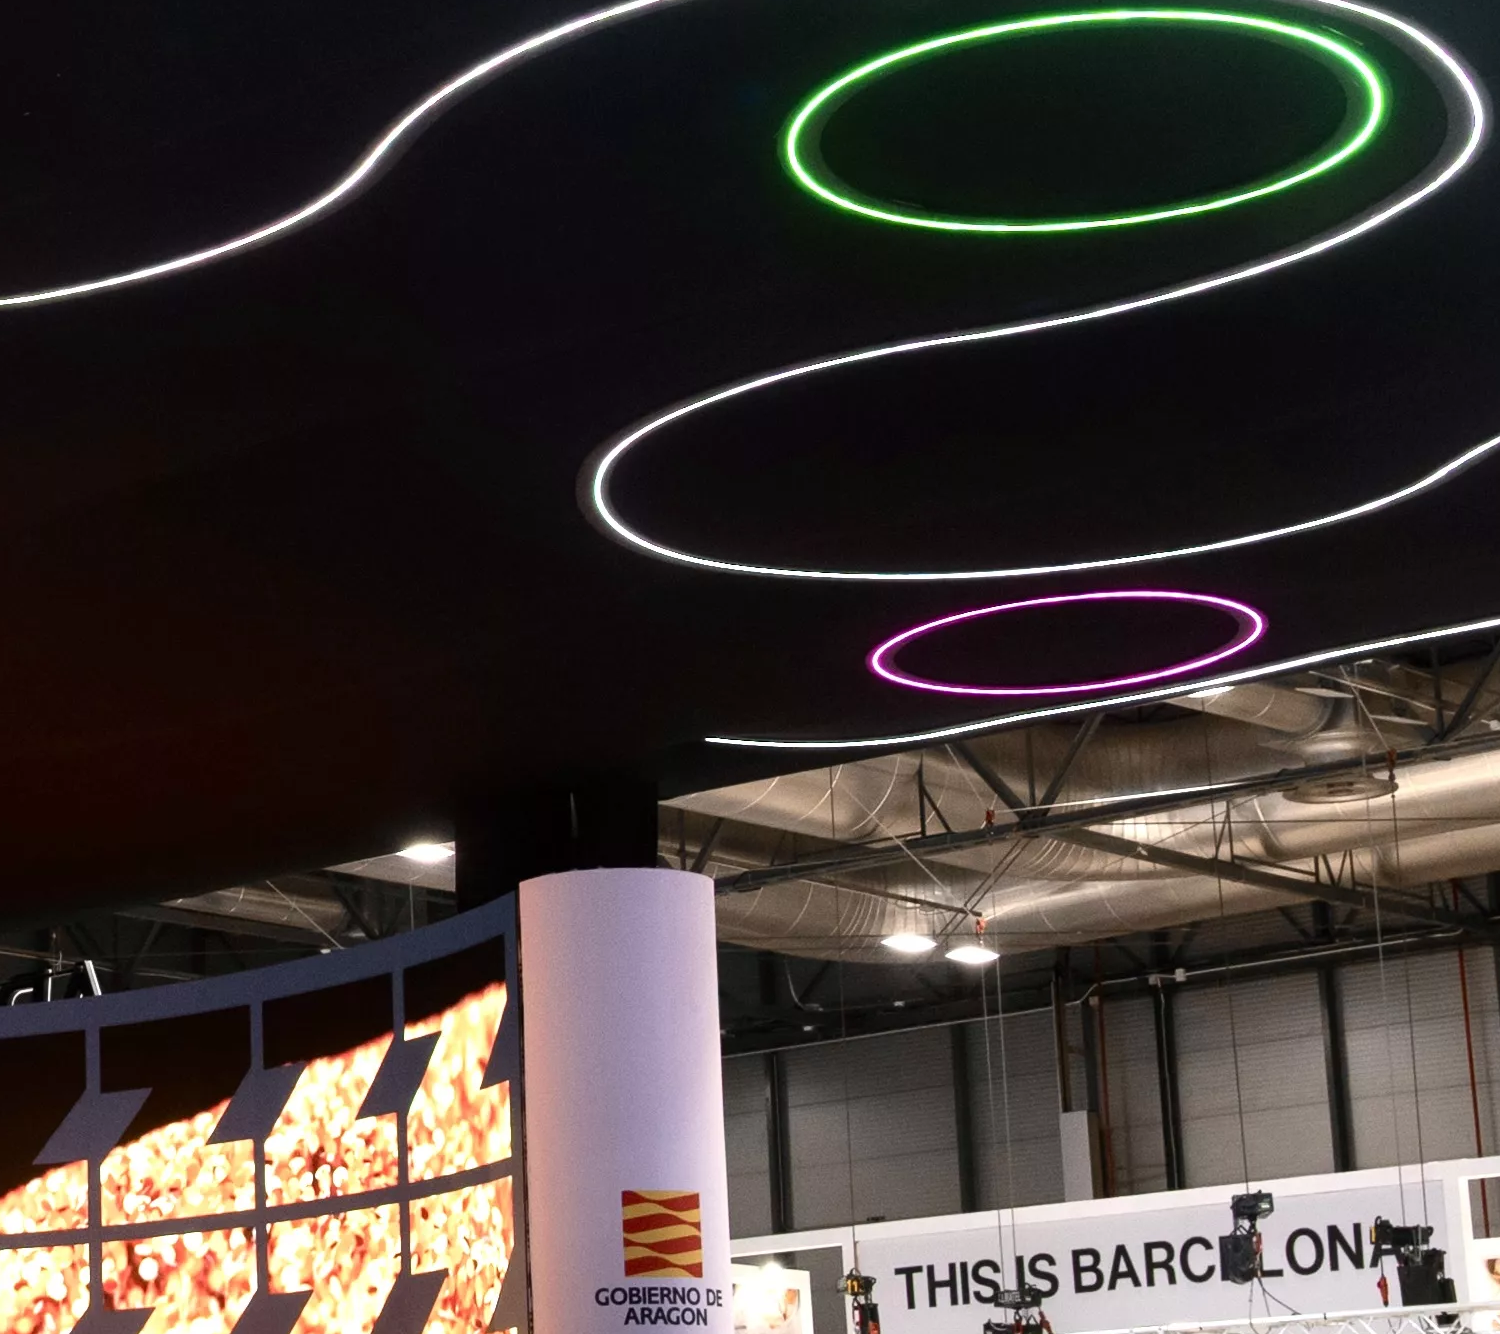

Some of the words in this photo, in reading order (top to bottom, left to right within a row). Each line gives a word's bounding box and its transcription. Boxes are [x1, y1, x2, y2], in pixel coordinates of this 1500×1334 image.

[894, 1258, 1001, 1310] THIS
[1014, 1252, 1059, 1298] IS
[594, 1286, 701, 1307] GOBIERNO
[705, 1288, 723, 1307] DE
[623, 1306, 708, 1326] ARAGON
